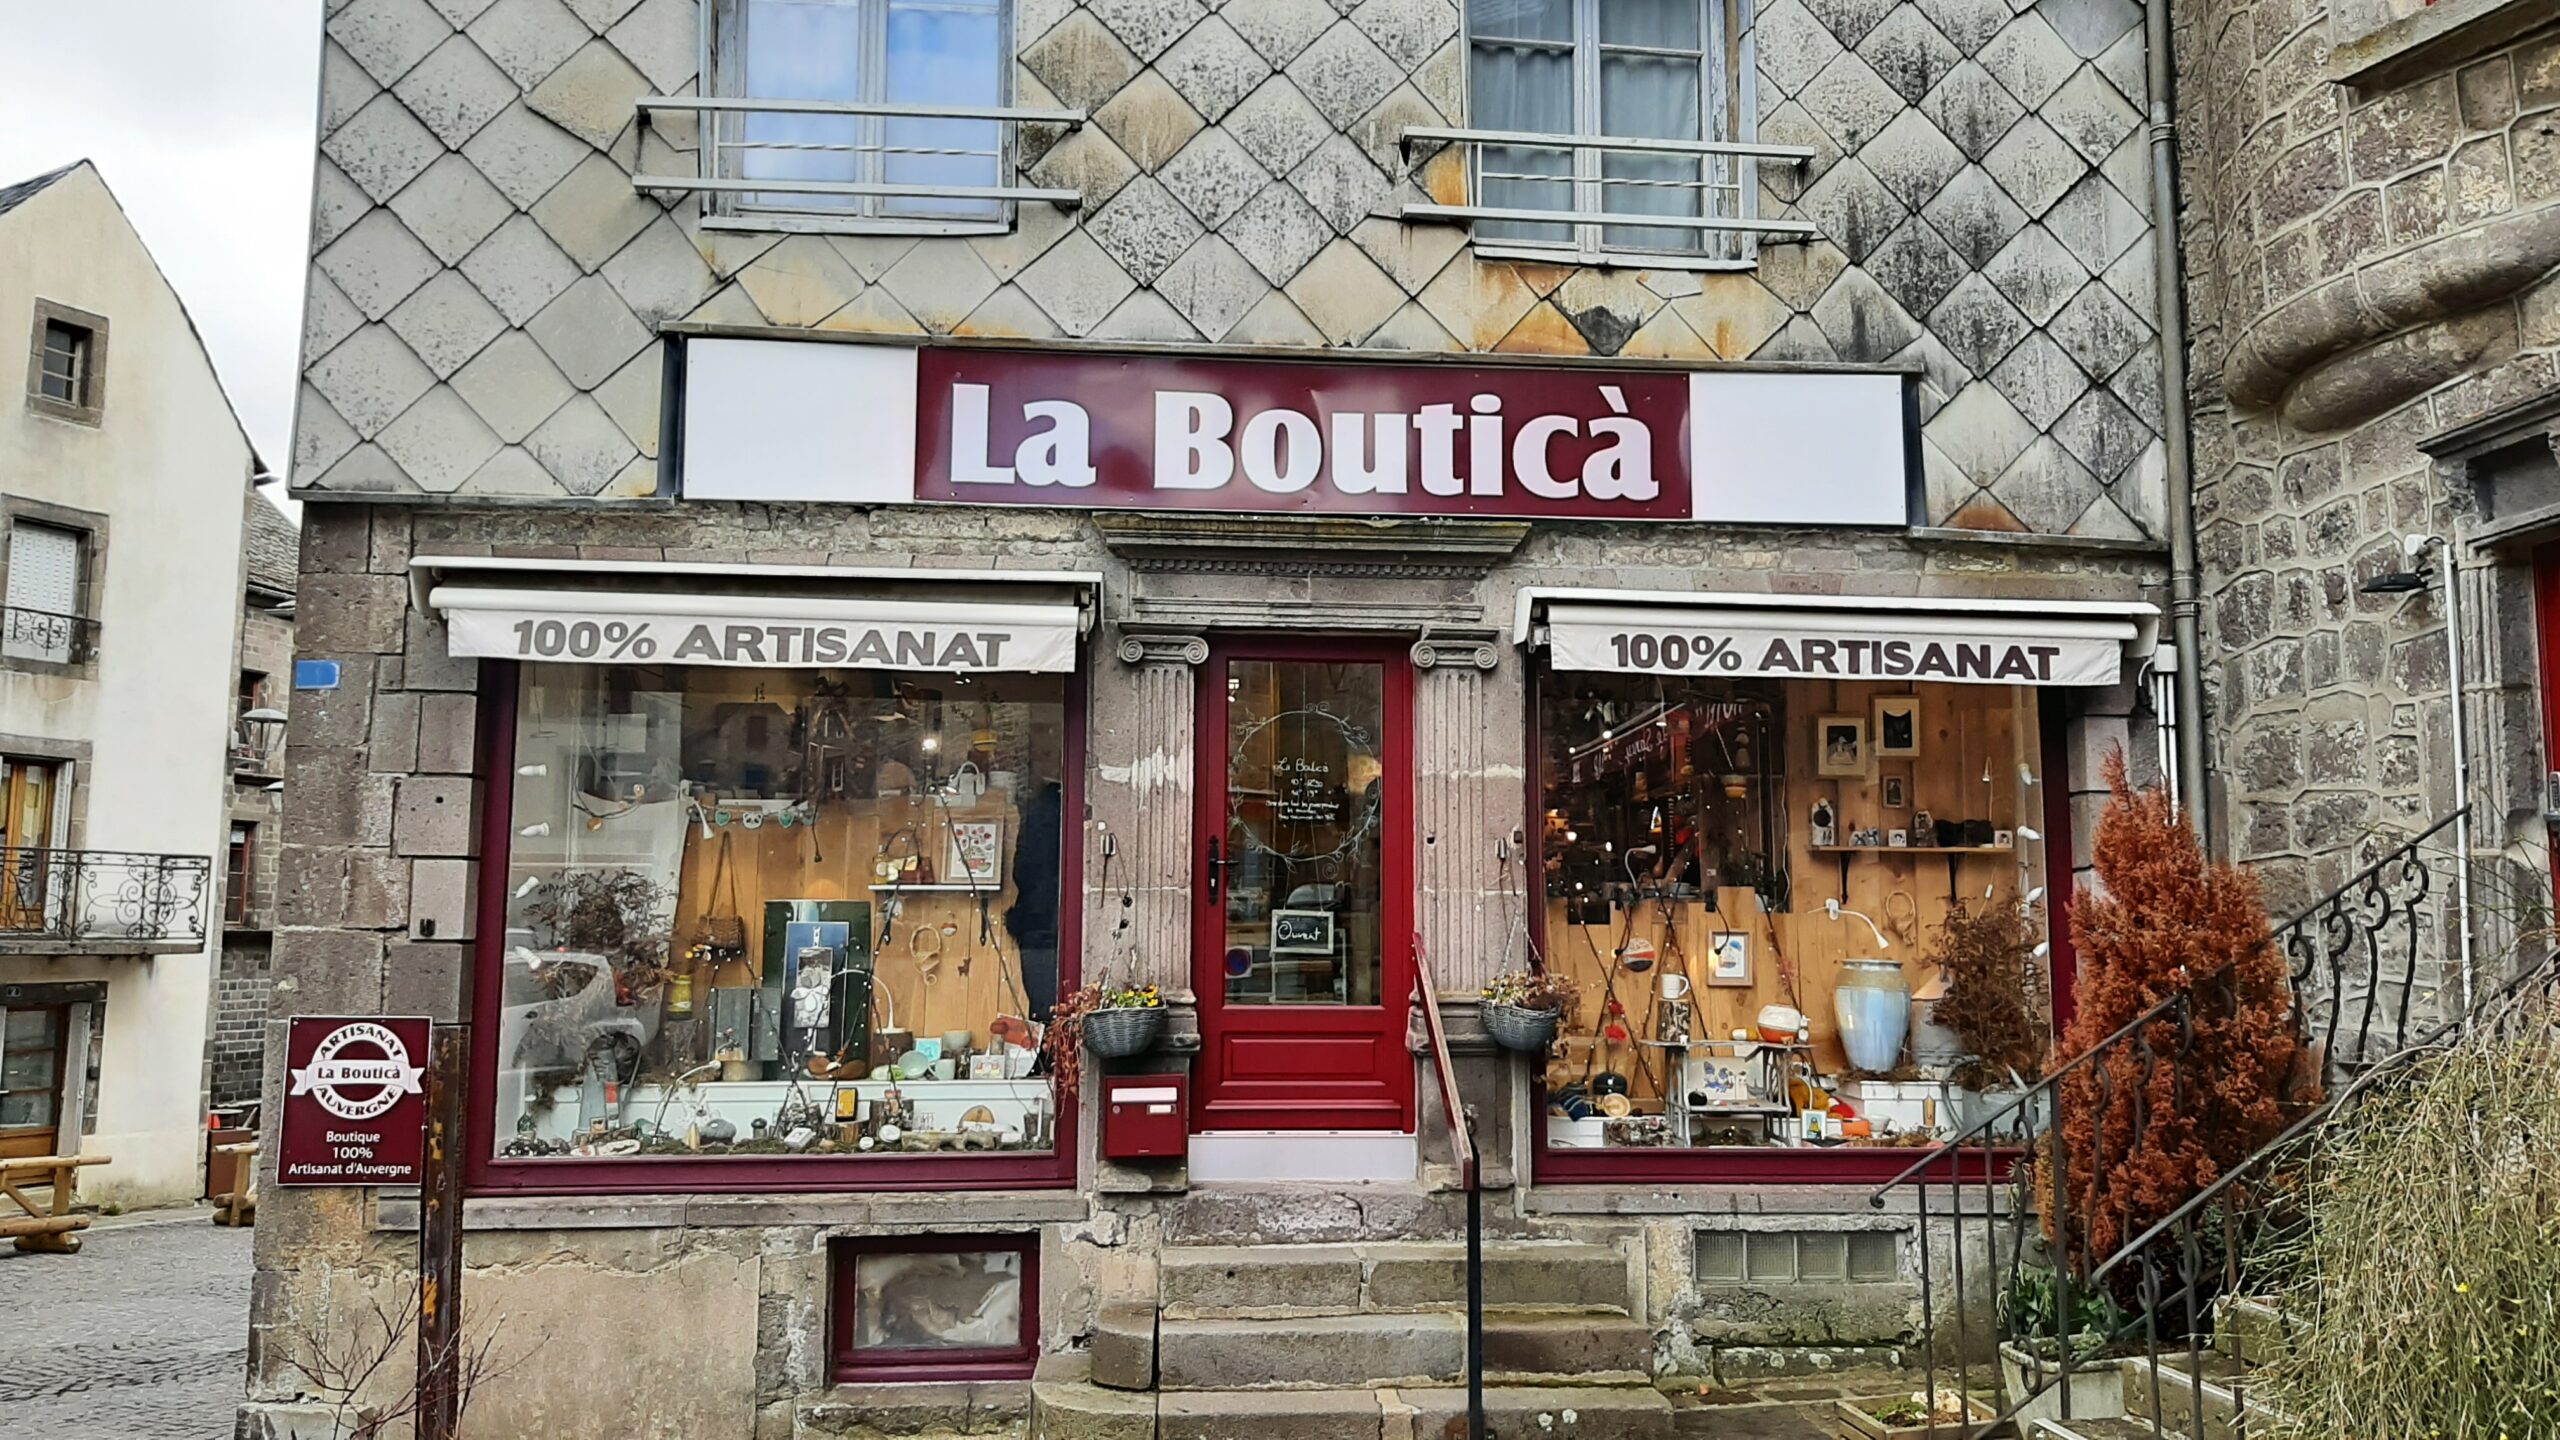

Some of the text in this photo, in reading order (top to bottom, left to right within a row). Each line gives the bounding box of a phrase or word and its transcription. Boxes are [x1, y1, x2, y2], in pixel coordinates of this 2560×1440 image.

[949, 382, 1660, 501] La Bouticà
[513, 619, 1011, 668] 100% ARTISANAT
[1611, 633, 2060, 680] 100% ARTISANAT
[320, 1025, 405, 1059] ARTISANAT
[318, 1065, 401, 1080] La Bouticà
[316, 1087, 399, 1116] AUVERGNE
[326, 1131, 381, 1144] Boutique
[332, 1147, 374, 1159] 100%
[288, 1162, 412, 1177] Artisanat d'Auvergne
